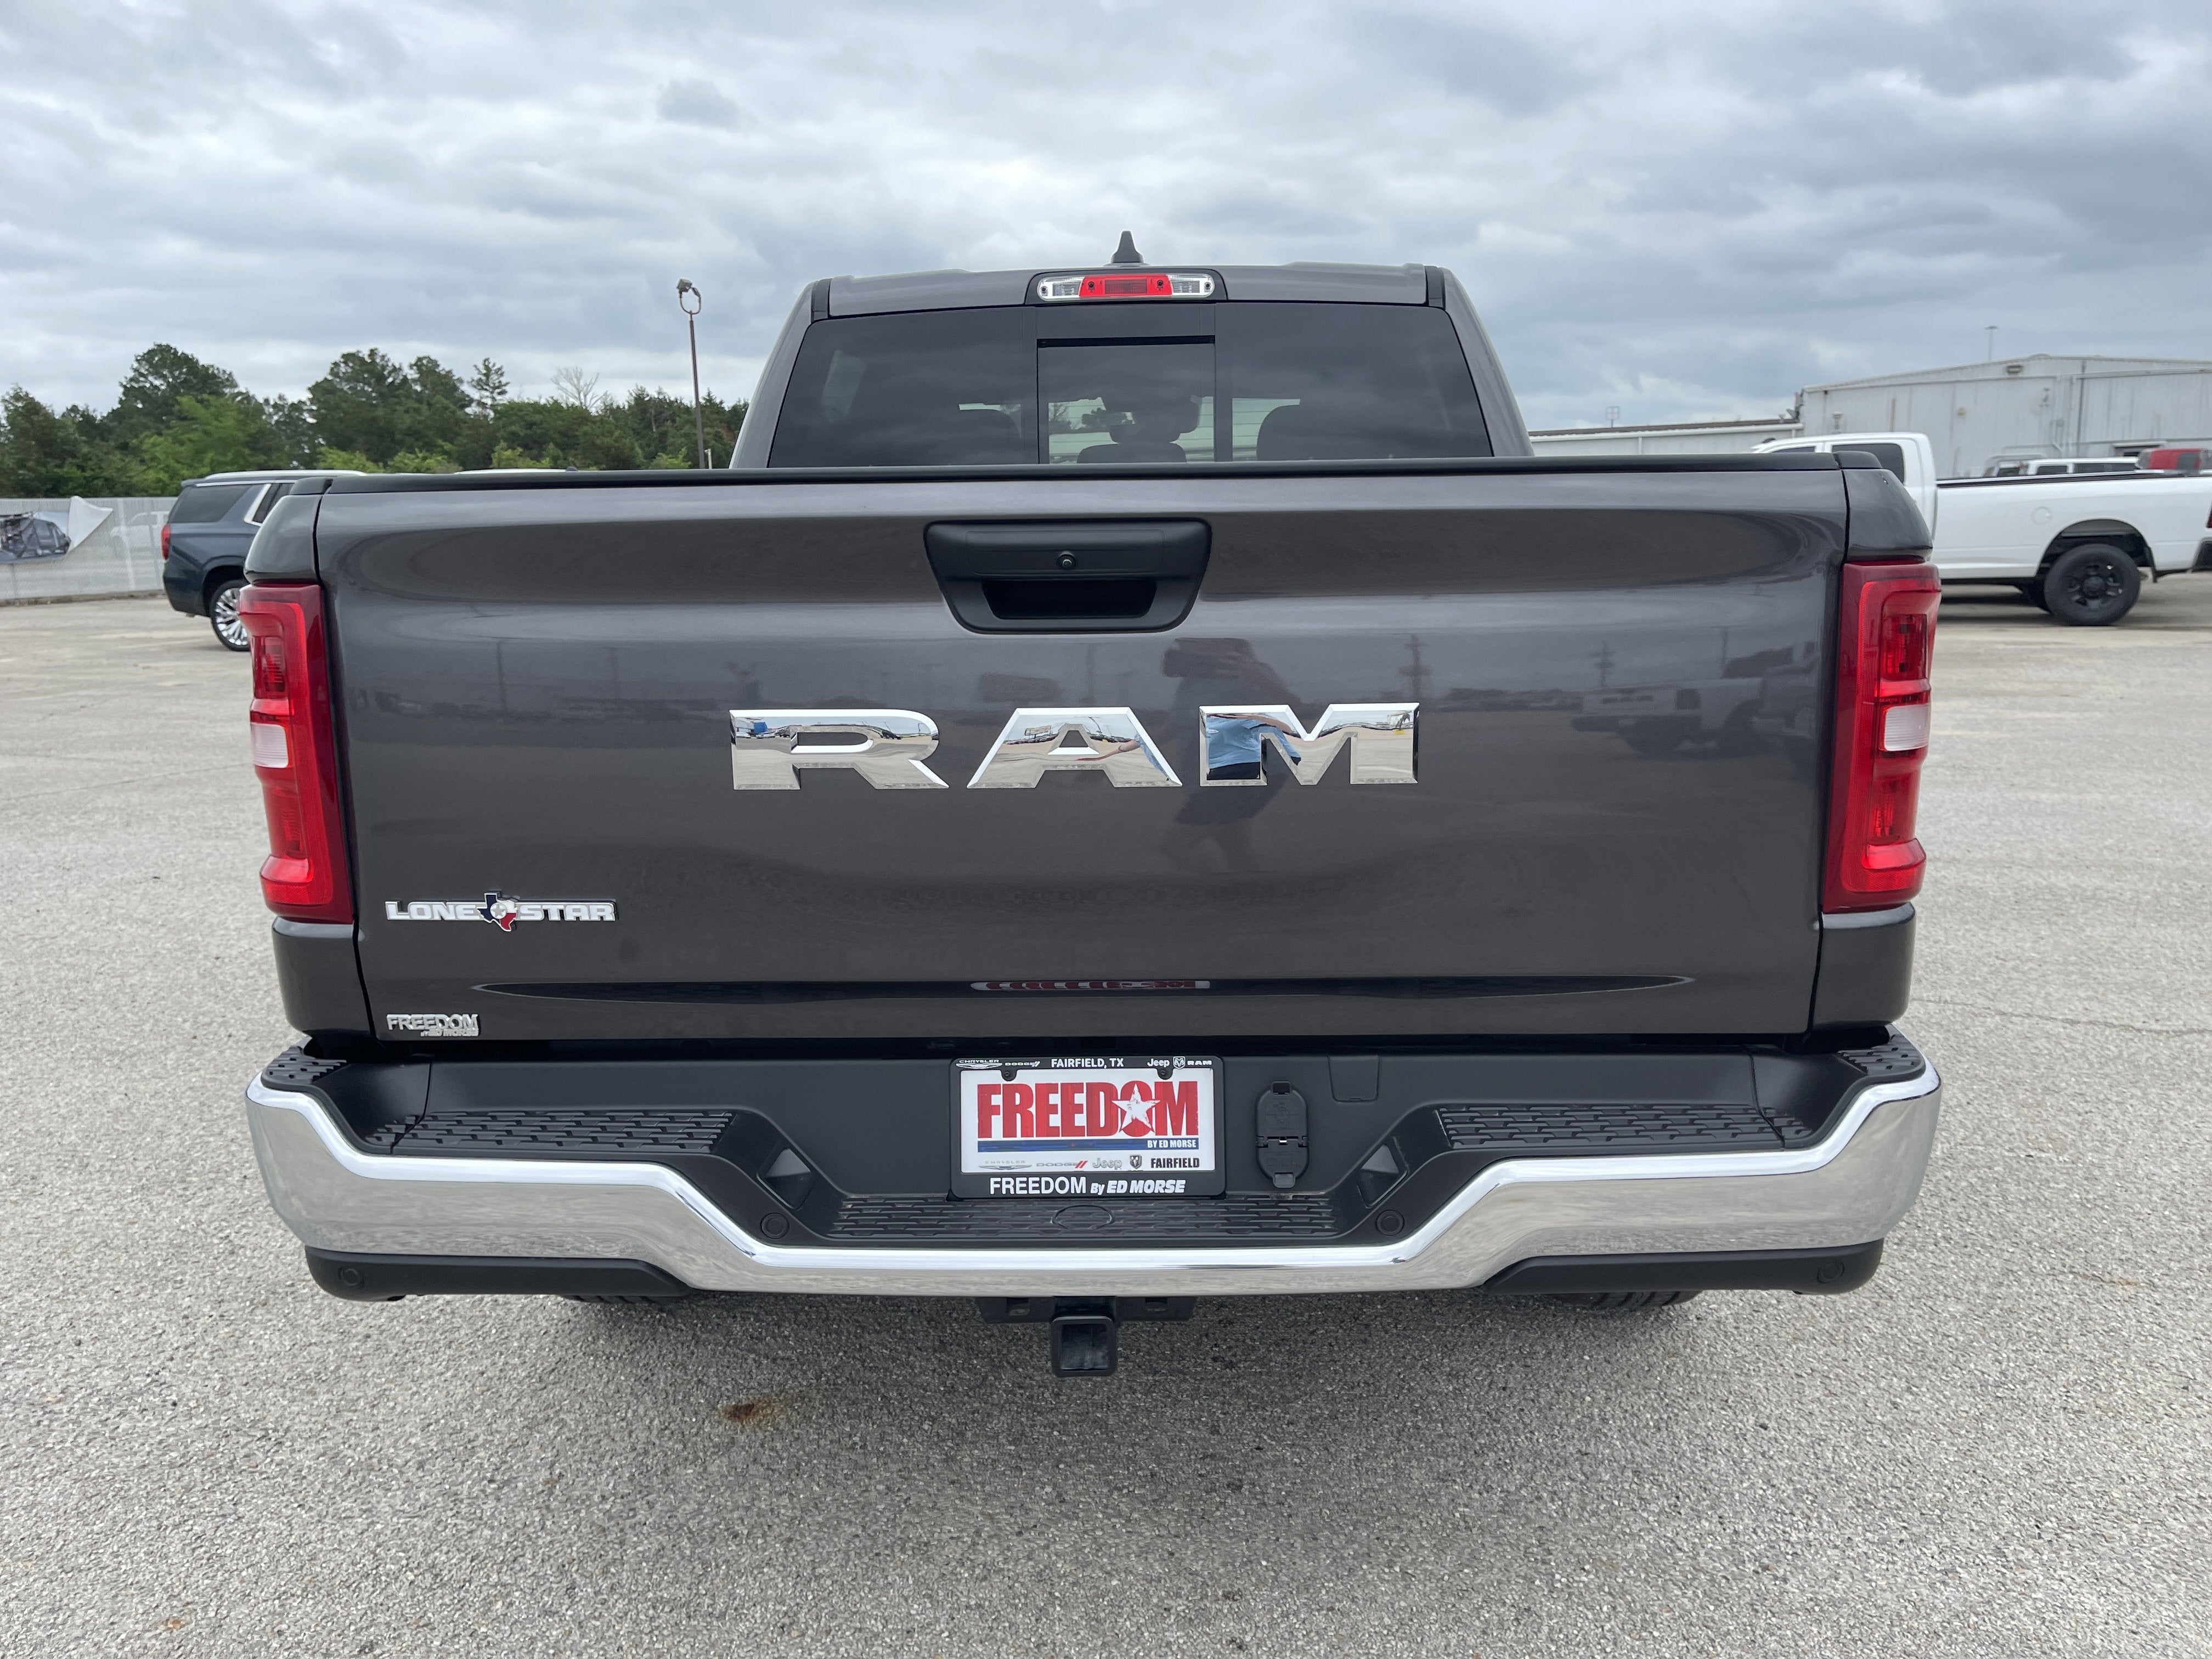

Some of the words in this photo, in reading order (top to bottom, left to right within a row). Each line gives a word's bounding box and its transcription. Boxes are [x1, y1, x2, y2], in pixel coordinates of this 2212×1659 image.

[729, 702, 1420, 790] RAM
[385, 901, 481, 921] LONE
[518, 902, 616, 921] STAR
[387, 1014, 478, 1030] FREEDOM
[1051, 1058, 1107, 1069] FAIRFIELD,
[1109, 1058, 1124, 1068] TX
[1147, 1058, 1170, 1068] Jeep
[978, 1080, 1199, 1138] FREEDOM
[1147, 1140, 1157, 1148] BY
[1170, 1139, 1197, 1148] MORSE
[1092, 1158, 1122, 1170] Jeep
[1151, 1158, 1200, 1169] FAIRFIELD
[990, 1177, 1086, 1194] FREEDOM
[1107, 1180, 1127, 1194] ED
[1129, 1180, 1186, 1193] MORSE
